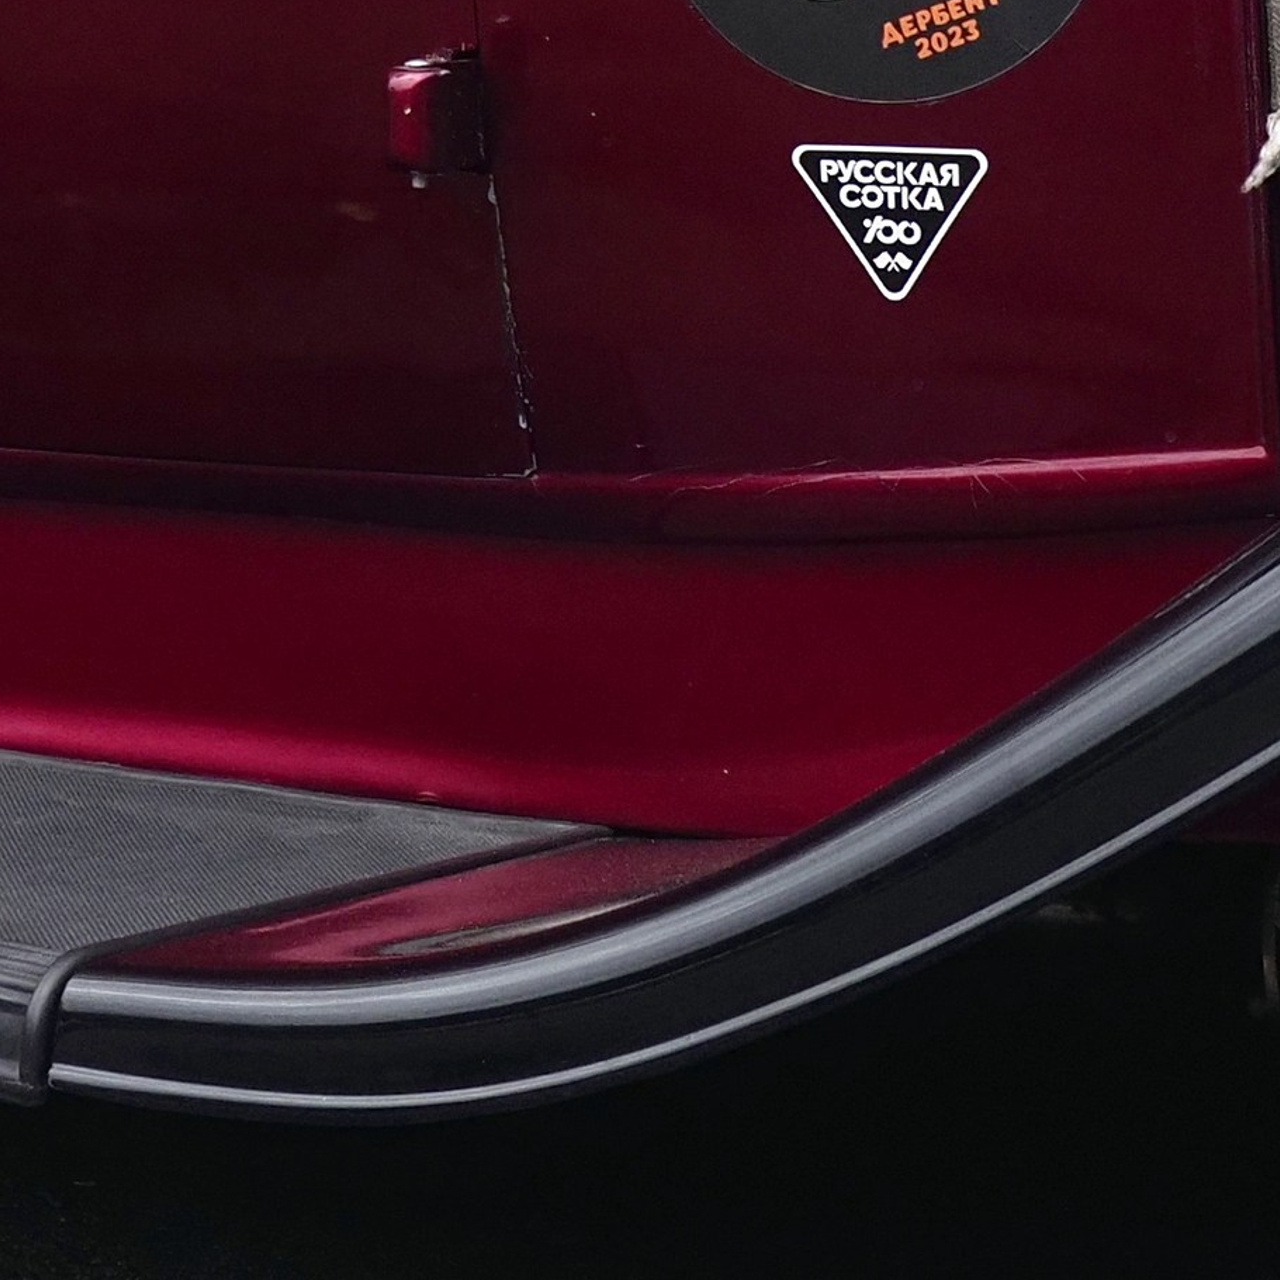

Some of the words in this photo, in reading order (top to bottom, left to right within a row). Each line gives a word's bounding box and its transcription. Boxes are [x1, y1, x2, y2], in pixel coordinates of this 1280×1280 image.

[914, 19, 980, 59] 2023
[820, 159, 960, 187] РУССКАЯ
[839, 183, 944, 211] СОТКА
